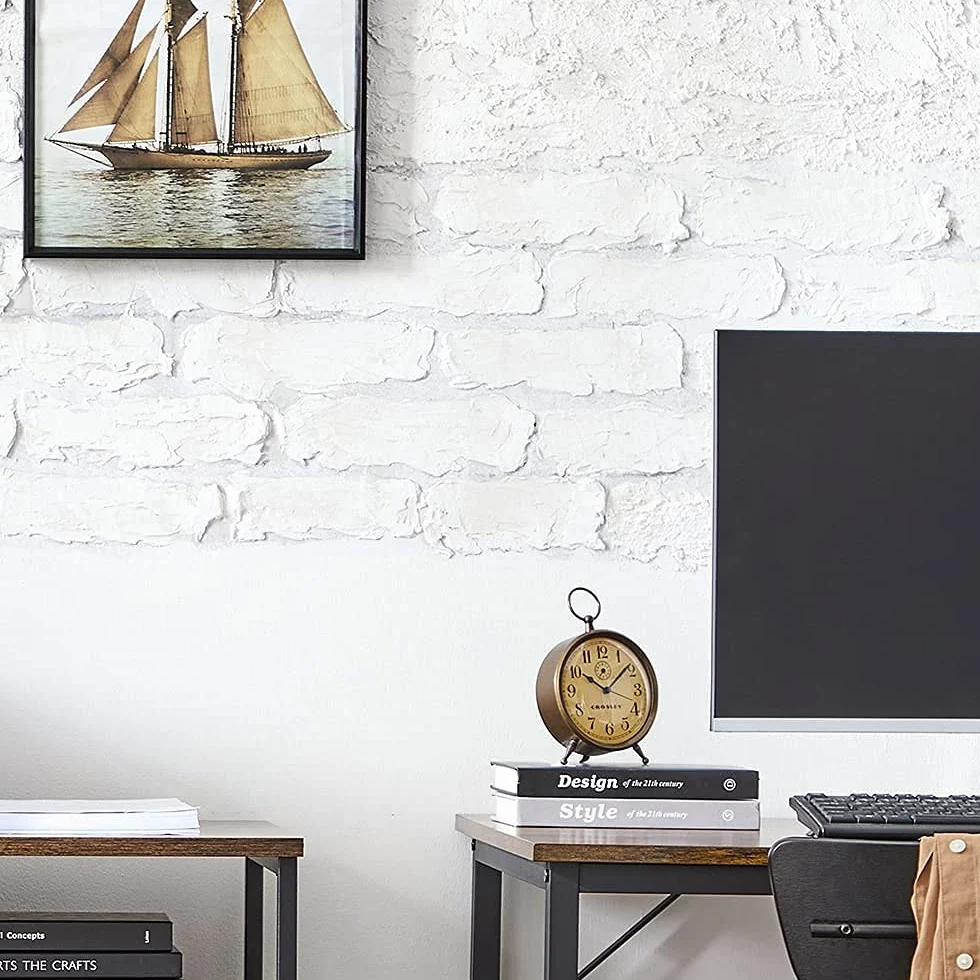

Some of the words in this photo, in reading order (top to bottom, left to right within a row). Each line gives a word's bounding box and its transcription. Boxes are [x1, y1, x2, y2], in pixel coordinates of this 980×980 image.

[582, 650, 591, 663] 11
[596, 645, 608, 660] 12
[570, 665, 581, 679] 10
[628, 664, 637, 678] 2
[567, 683, 576, 698] 9
[633, 683, 642, 697] 3
[575, 703, 584, 716] 8
[630, 702, 640, 716] 4
[587, 717, 596, 730] 7
[605, 722, 614, 736] 6
[620, 717, 630, 731] 5
[557, 774, 619, 792] Design
[622, 779, 632, 789] of
[658, 780, 684, 789] century
[559, 803, 618, 823] Style
[626, 810, 636, 820] of
[636, 810, 647, 818] the
[663, 811, 689, 820] century
[6, 931, 45, 940] Concepts
[22, 960, 47, 971] THE
[52, 960, 97, 971] CRAFTS
